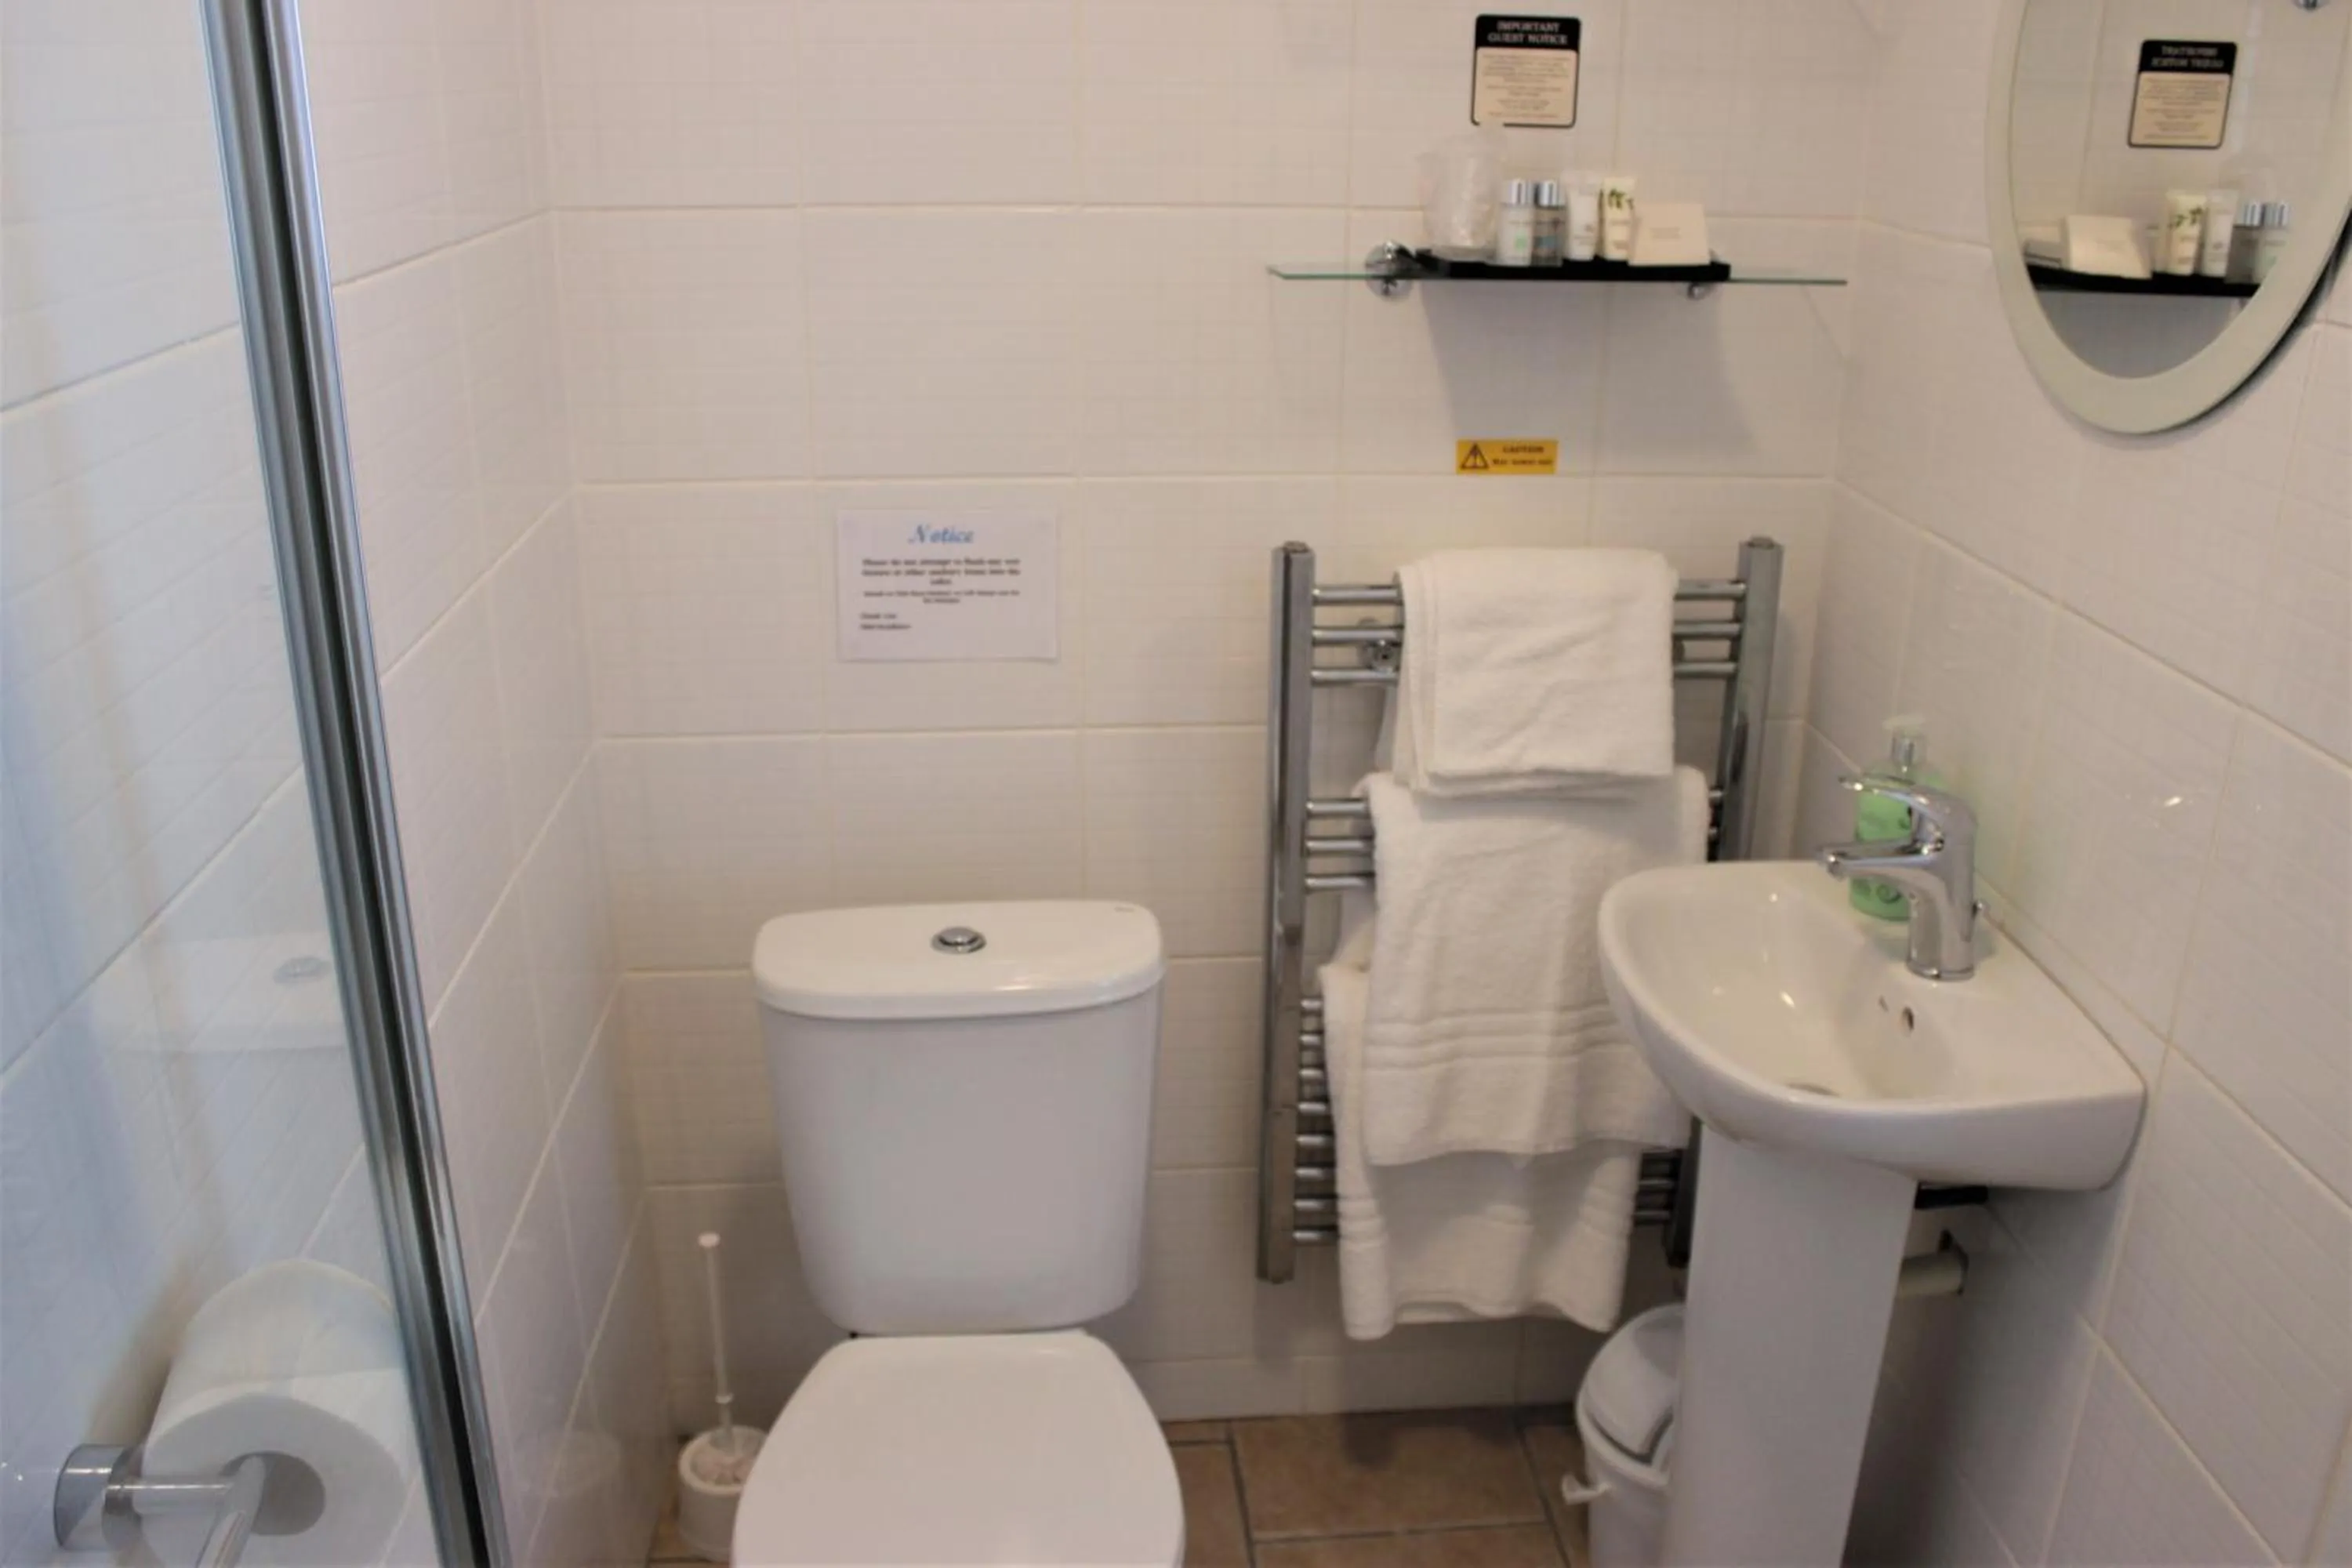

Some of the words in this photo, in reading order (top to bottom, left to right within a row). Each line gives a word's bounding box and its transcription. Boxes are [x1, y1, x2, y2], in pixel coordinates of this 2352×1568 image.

[1496, 20, 1561, 32] IMPORTANT
[1487, 31, 1525, 43] GUEST
[1527, 33, 1569, 45] NOTICE
[906, 523, 975, 545] Notice
